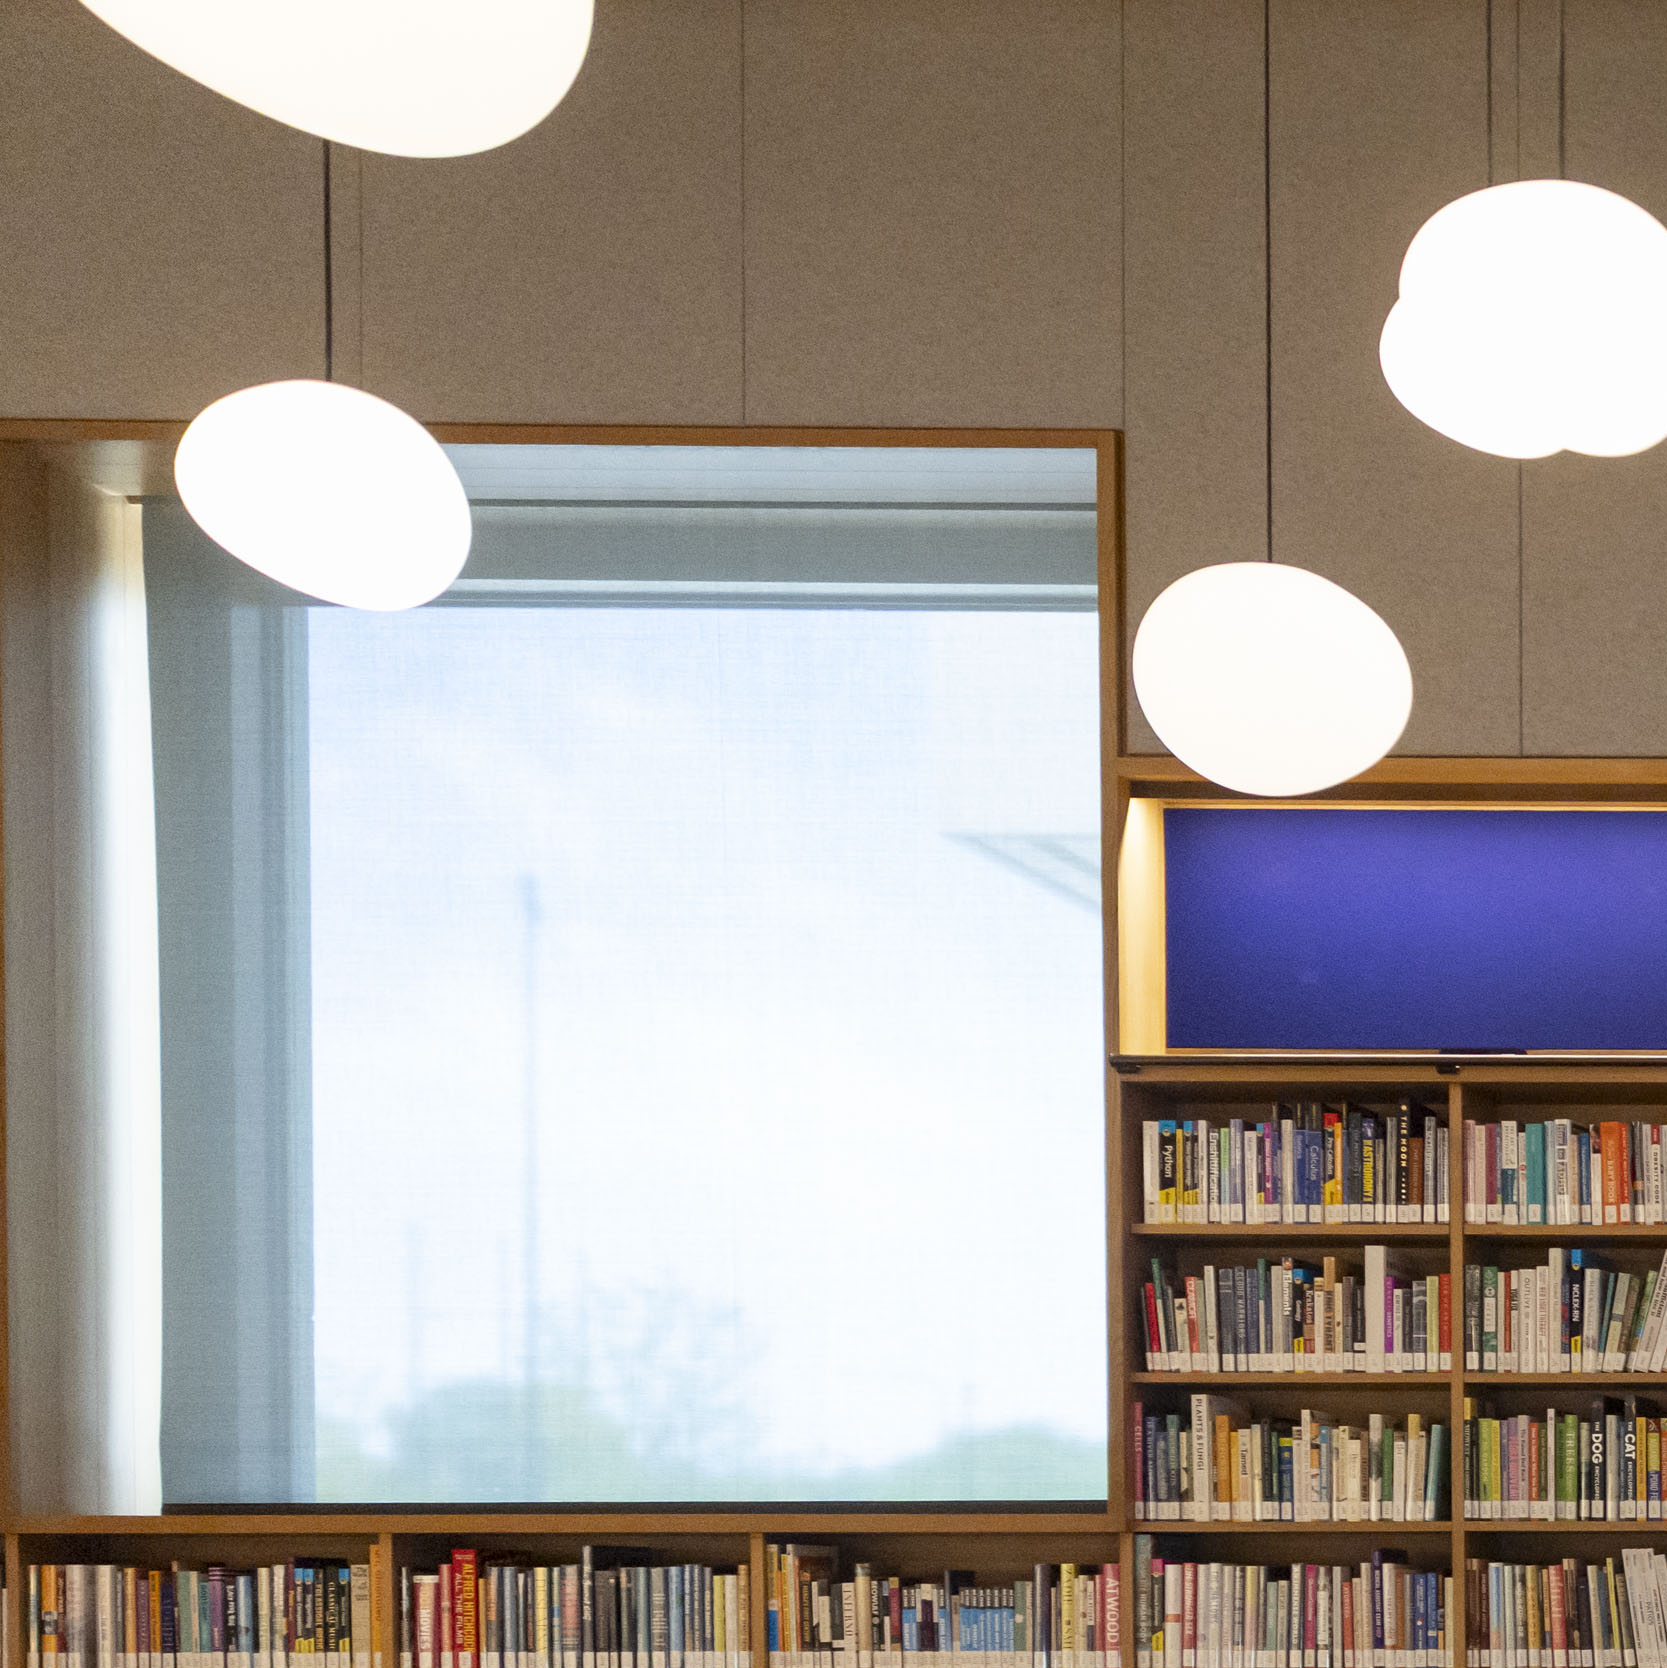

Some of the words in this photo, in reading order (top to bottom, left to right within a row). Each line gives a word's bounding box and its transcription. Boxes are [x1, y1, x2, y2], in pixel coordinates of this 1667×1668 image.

[1164, 1145, 1173, 1178] Python
[1310, 1145, 1319, 1181] Calculus
[1282, 1277, 1291, 1315] Elements
[1572, 1284, 1580, 1321] NCLEX-RN
[1195, 1398, 1204, 1433] PLANTS
[1196, 1443, 1205, 1471] FUNGI
[1240, 1448, 1248, 1476] Tamed
[1567, 1433, 1575, 1473] TREES
[463, 1564, 474, 1599] ALFRED
[463, 1602, 475, 1653] HITCHCOCK
[1106, 1578, 1119, 1642] ATWOOD
[421, 1609, 430, 1650] MOVIES
